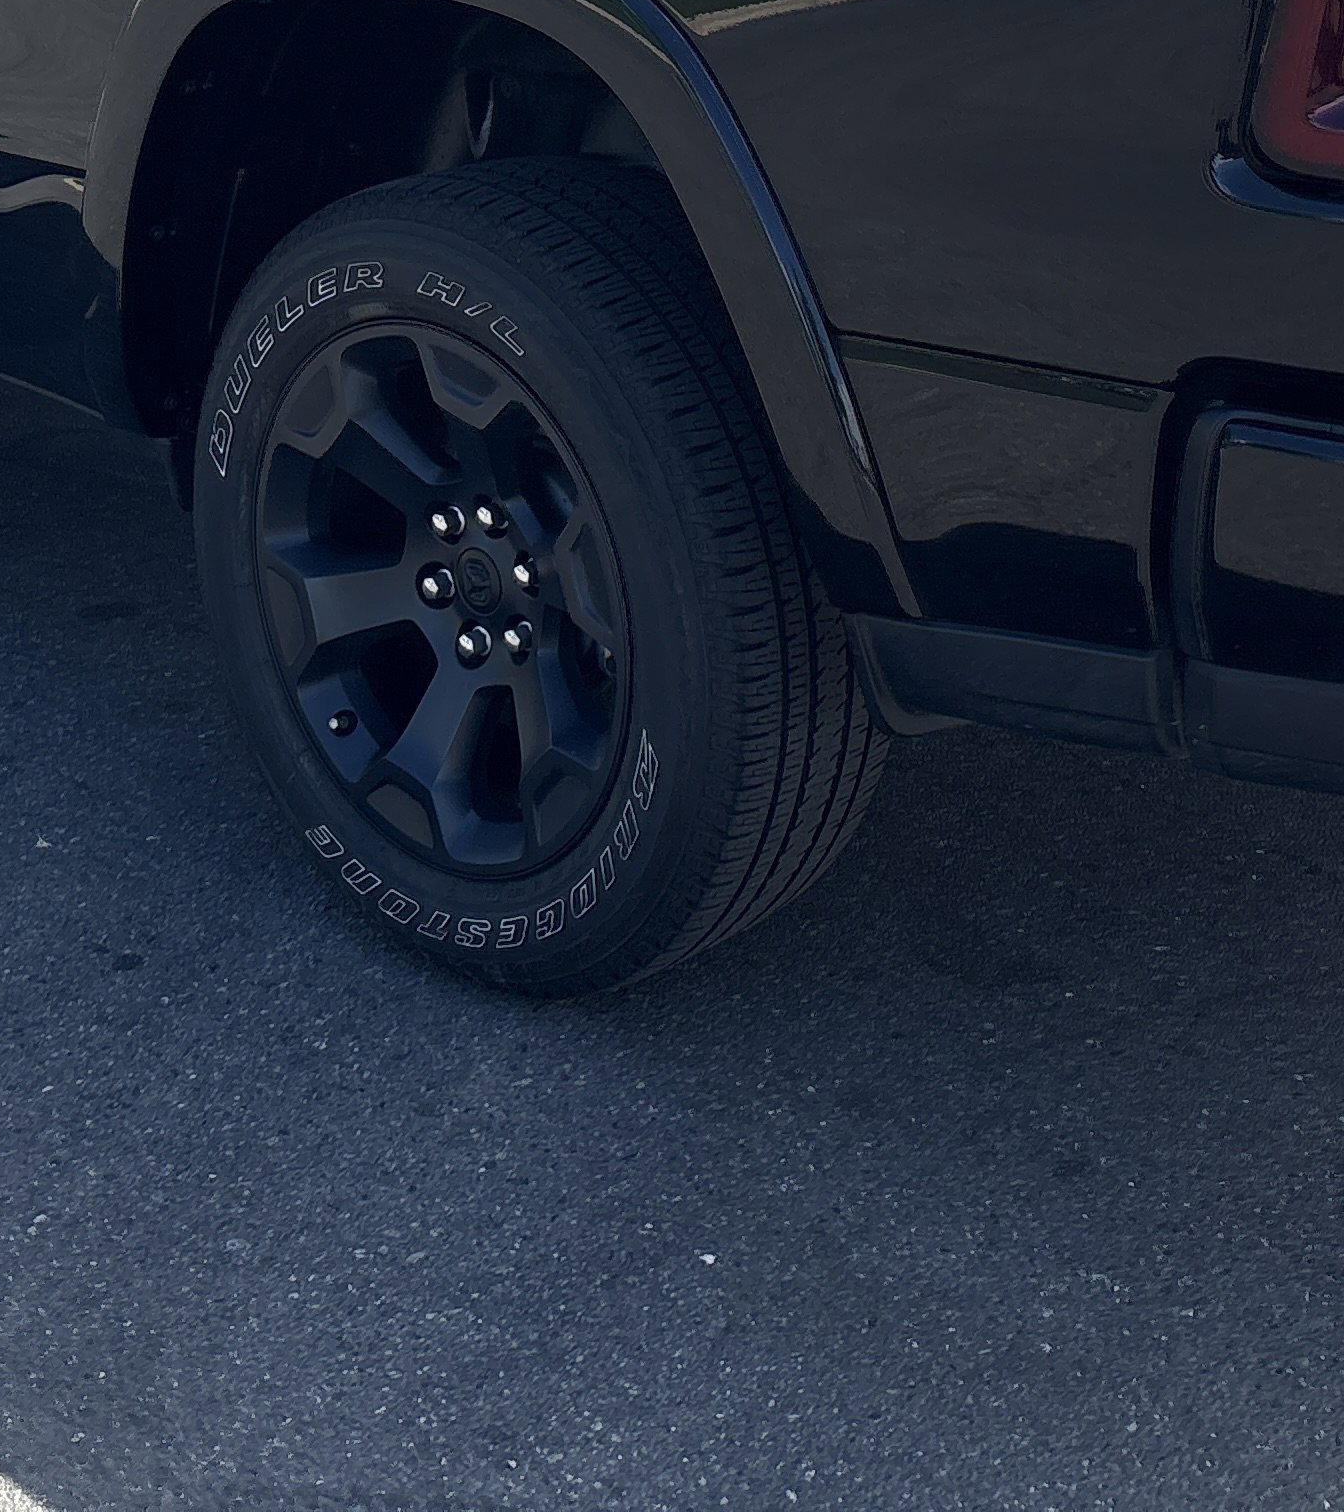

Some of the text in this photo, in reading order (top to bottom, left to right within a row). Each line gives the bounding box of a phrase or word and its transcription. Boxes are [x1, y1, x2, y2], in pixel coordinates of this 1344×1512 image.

[208, 260, 525, 477] DUELER H/L
[305, 727, 661, 950] BRIDGESTONE
